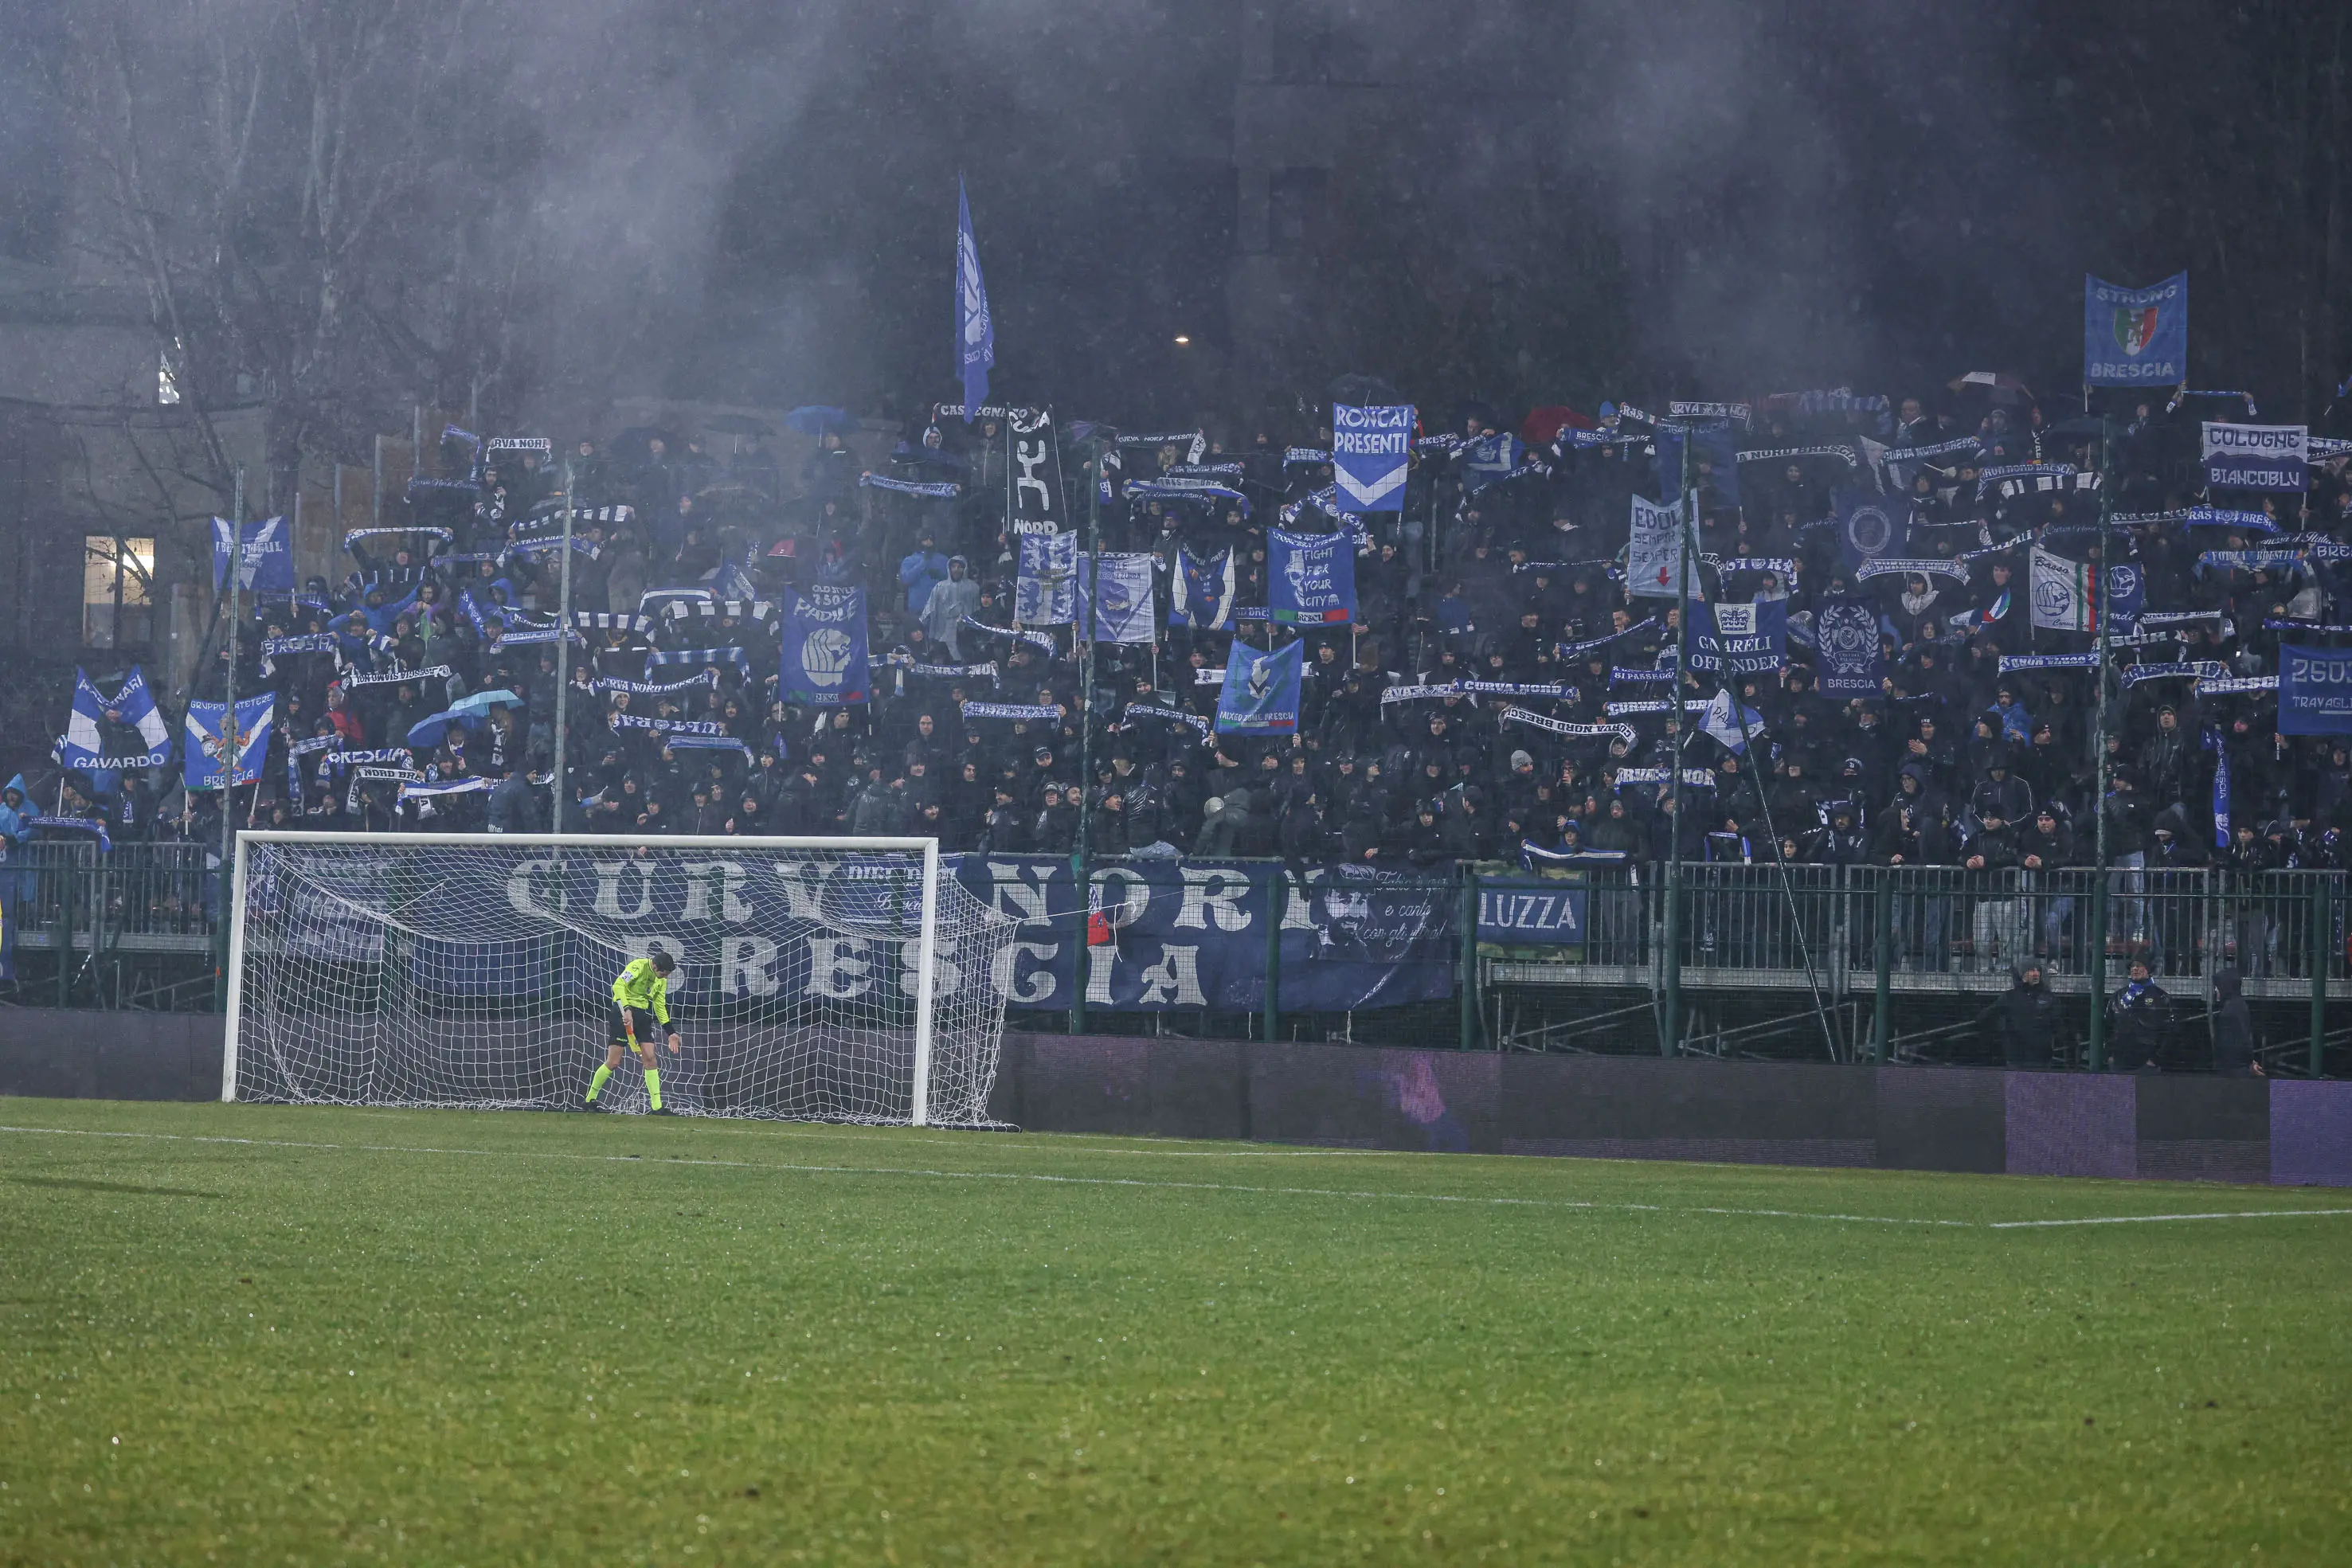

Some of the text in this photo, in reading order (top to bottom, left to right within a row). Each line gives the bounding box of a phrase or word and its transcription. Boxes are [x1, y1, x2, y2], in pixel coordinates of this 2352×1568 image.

[2096, 284, 2178, 303] STRONG
[2090, 362, 2175, 377] BRESCIA
[1671, 403, 1699, 414] URVA
[1336, 405, 1409, 428] RONCAI
[495, 440, 516, 448] RVA
[1334, 432, 1407, 454] PRESENTI
[2209, 428, 2299, 448] COLOGNE
[2189, 511, 2211, 520] RAS
[1014, 518, 1058, 535] NORD
[1304, 546, 1335, 561] FIGHT
[1306, 564, 1329, 576] FOR
[2035, 556, 2070, 574] Basso
[812, 585, 831, 593] OLD
[1304, 579, 1333, 592] YOUR
[1305, 596, 1327, 607] CITY
[372, 673, 399, 683] SIAMO
[631, 682, 662, 693] NORD
[664, 674, 710, 690] BRESCIA
[1827, 678, 1877, 689] BRESCIA
[1464, 681, 1562, 694] CURVA NORD
[190, 694, 272, 711] GRUPPO ATETERE
[1219, 710, 1243, 721] MIXED
[1243, 713, 1263, 721] ZONE
[1557, 722, 1593, 733] NORD
[1596, 725, 1631, 738] CURVA
[73, 753, 166, 768] GAVARDO
[364, 768, 395, 778] NORD
[507, 859, 843, 924] CURV
[1385, 905, 1395, 917] e
[1477, 892, 1576, 929] LUZZA
[1363, 927, 1386, 940] con
[1386, 922, 1407, 948] gli
[623, 935, 1207, 1007] BRESCIA
